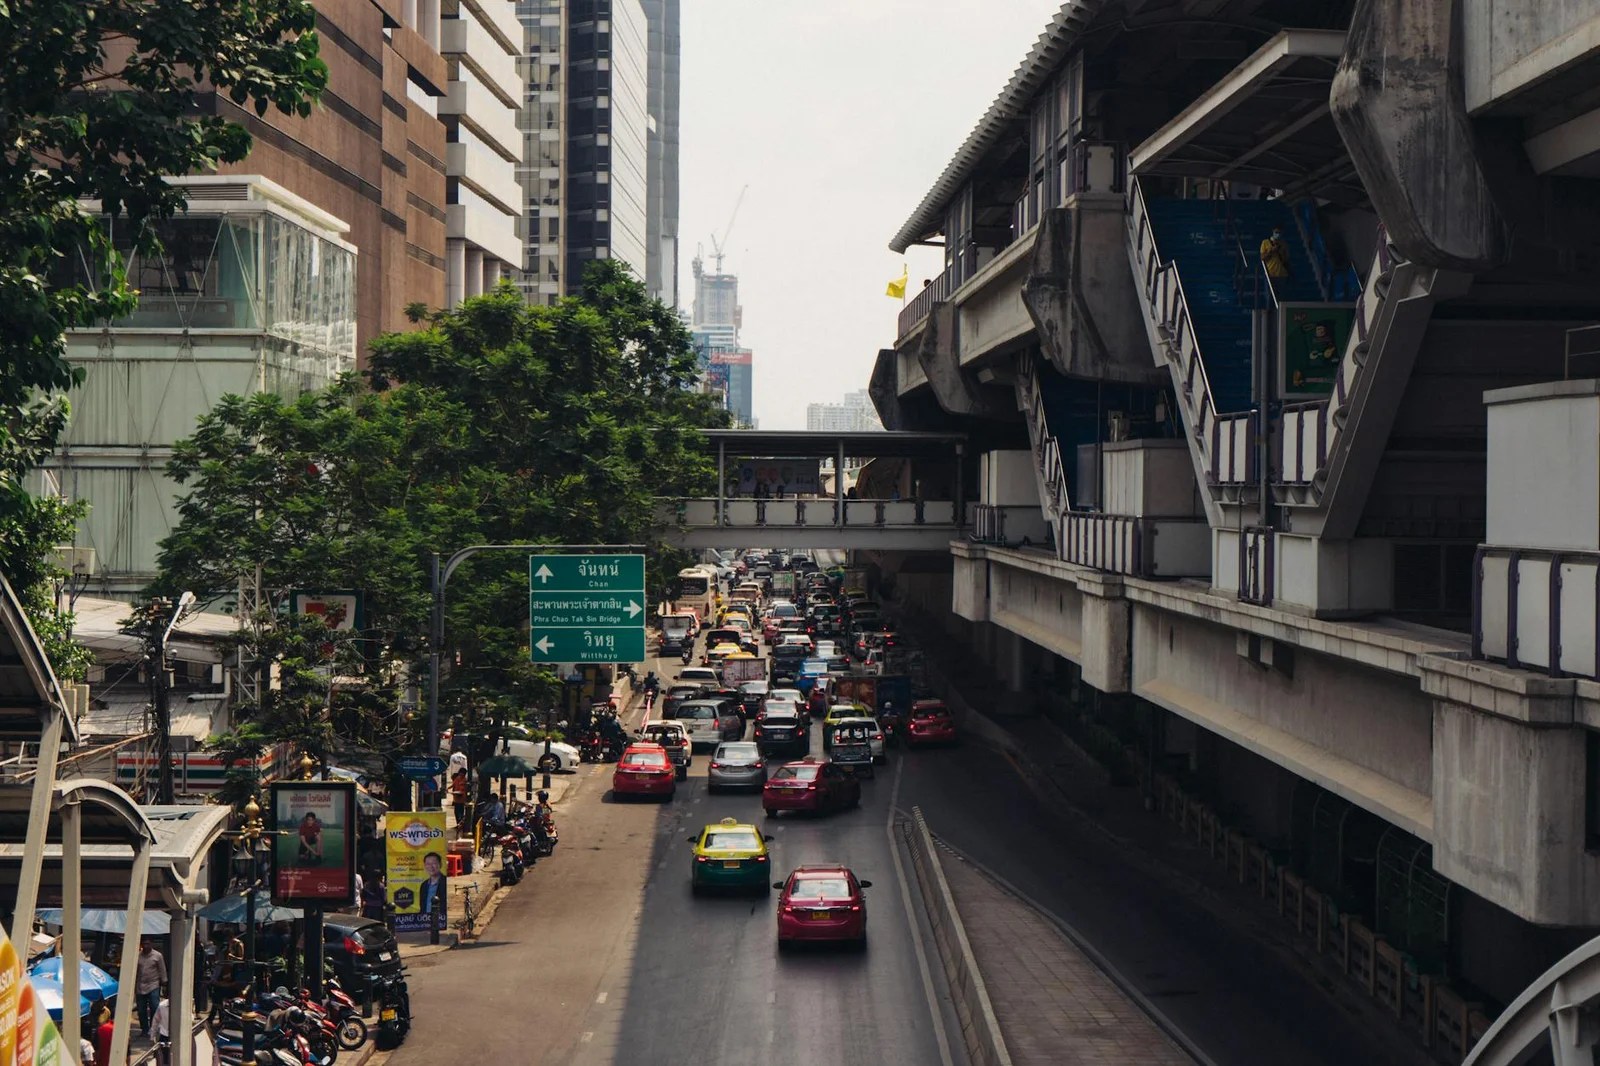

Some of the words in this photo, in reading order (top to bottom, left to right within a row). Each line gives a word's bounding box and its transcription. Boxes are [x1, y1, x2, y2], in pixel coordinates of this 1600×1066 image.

[578, 559, 620, 577] จันทน์
[588, 580, 609, 588] Chan
[533, 597, 622, 610] สะพานพระเจ้าตากสิน
[533, 615, 549, 623] Phra
[551, 615, 569, 623] Chao
[571, 615, 583, 623] Tak
[586, 615, 597, 623] Sin
[599, 615, 621, 624] Bridge
[583, 630, 615, 652] วิทยุ
[580, 652, 618, 660] Witthayu
[433, 760, 440, 770] 3
